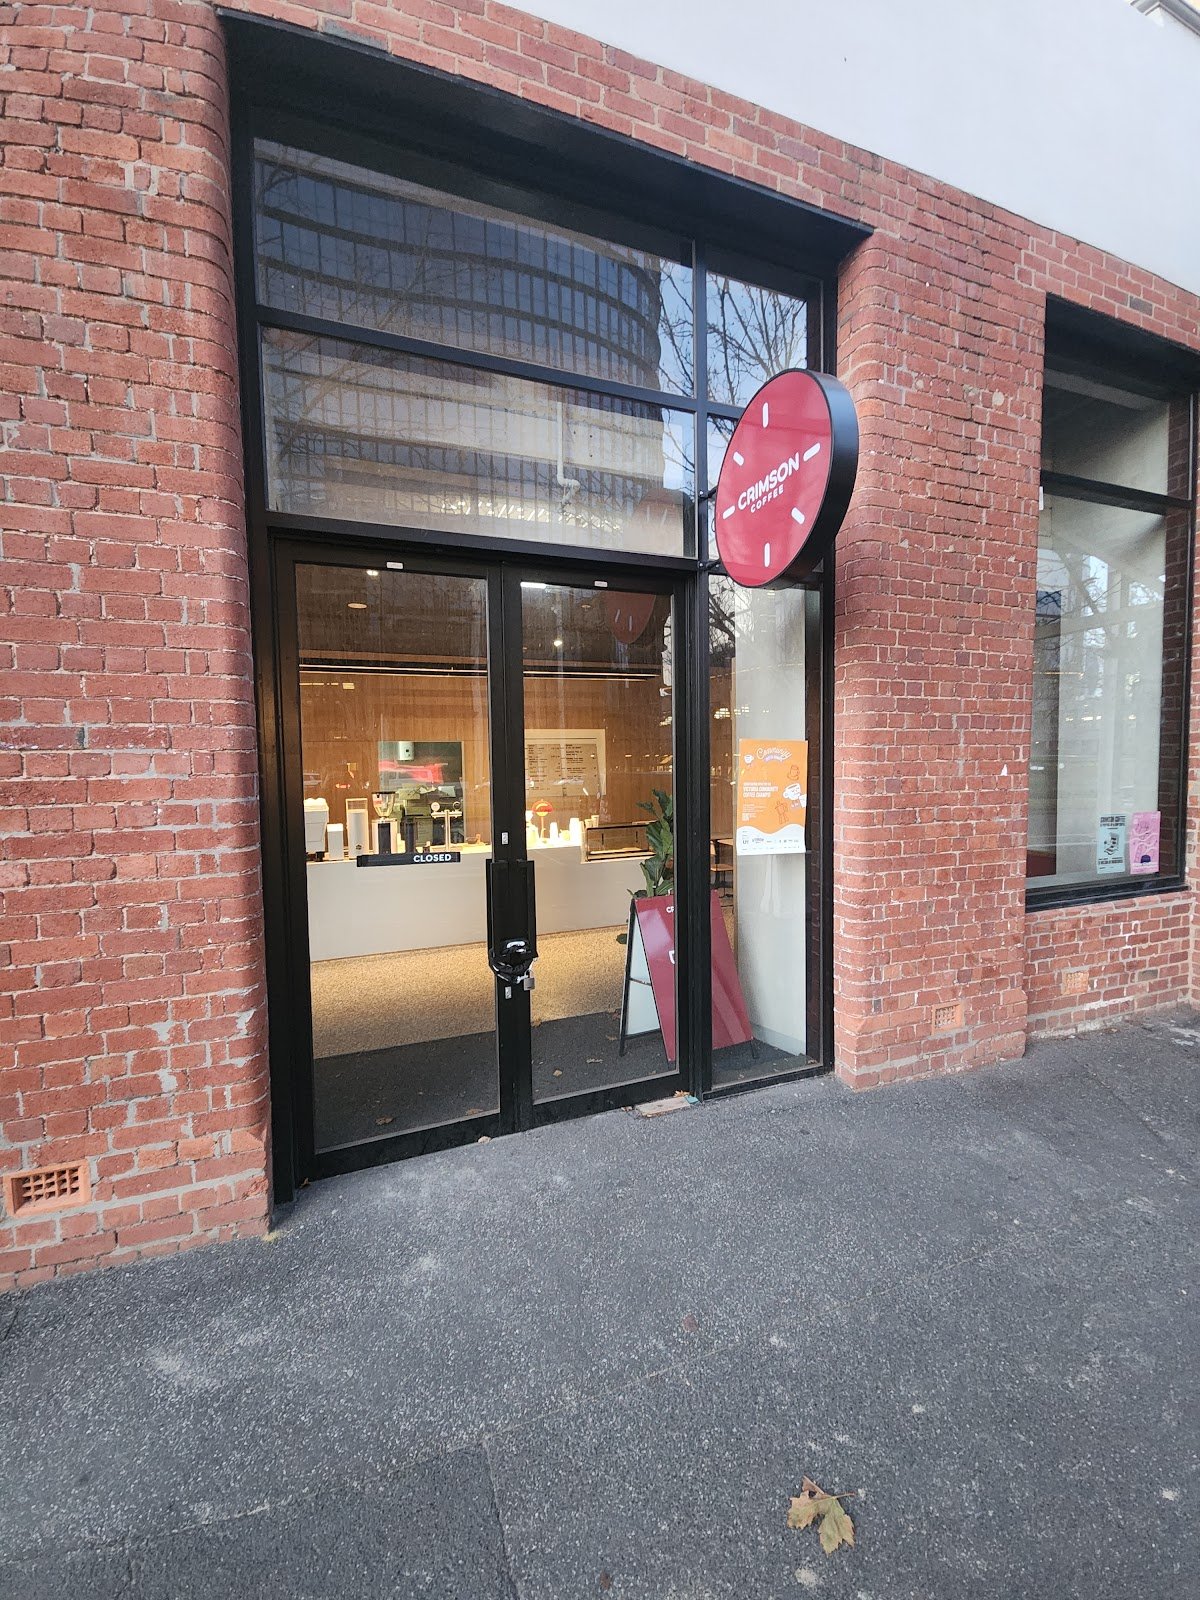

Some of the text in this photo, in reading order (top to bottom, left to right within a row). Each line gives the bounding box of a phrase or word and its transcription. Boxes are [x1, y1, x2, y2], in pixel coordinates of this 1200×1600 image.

[738, 452, 799, 510] CRIMSON
[750, 484, 784, 513] COFFEE
[413, 854, 452, 862] CLOSED
